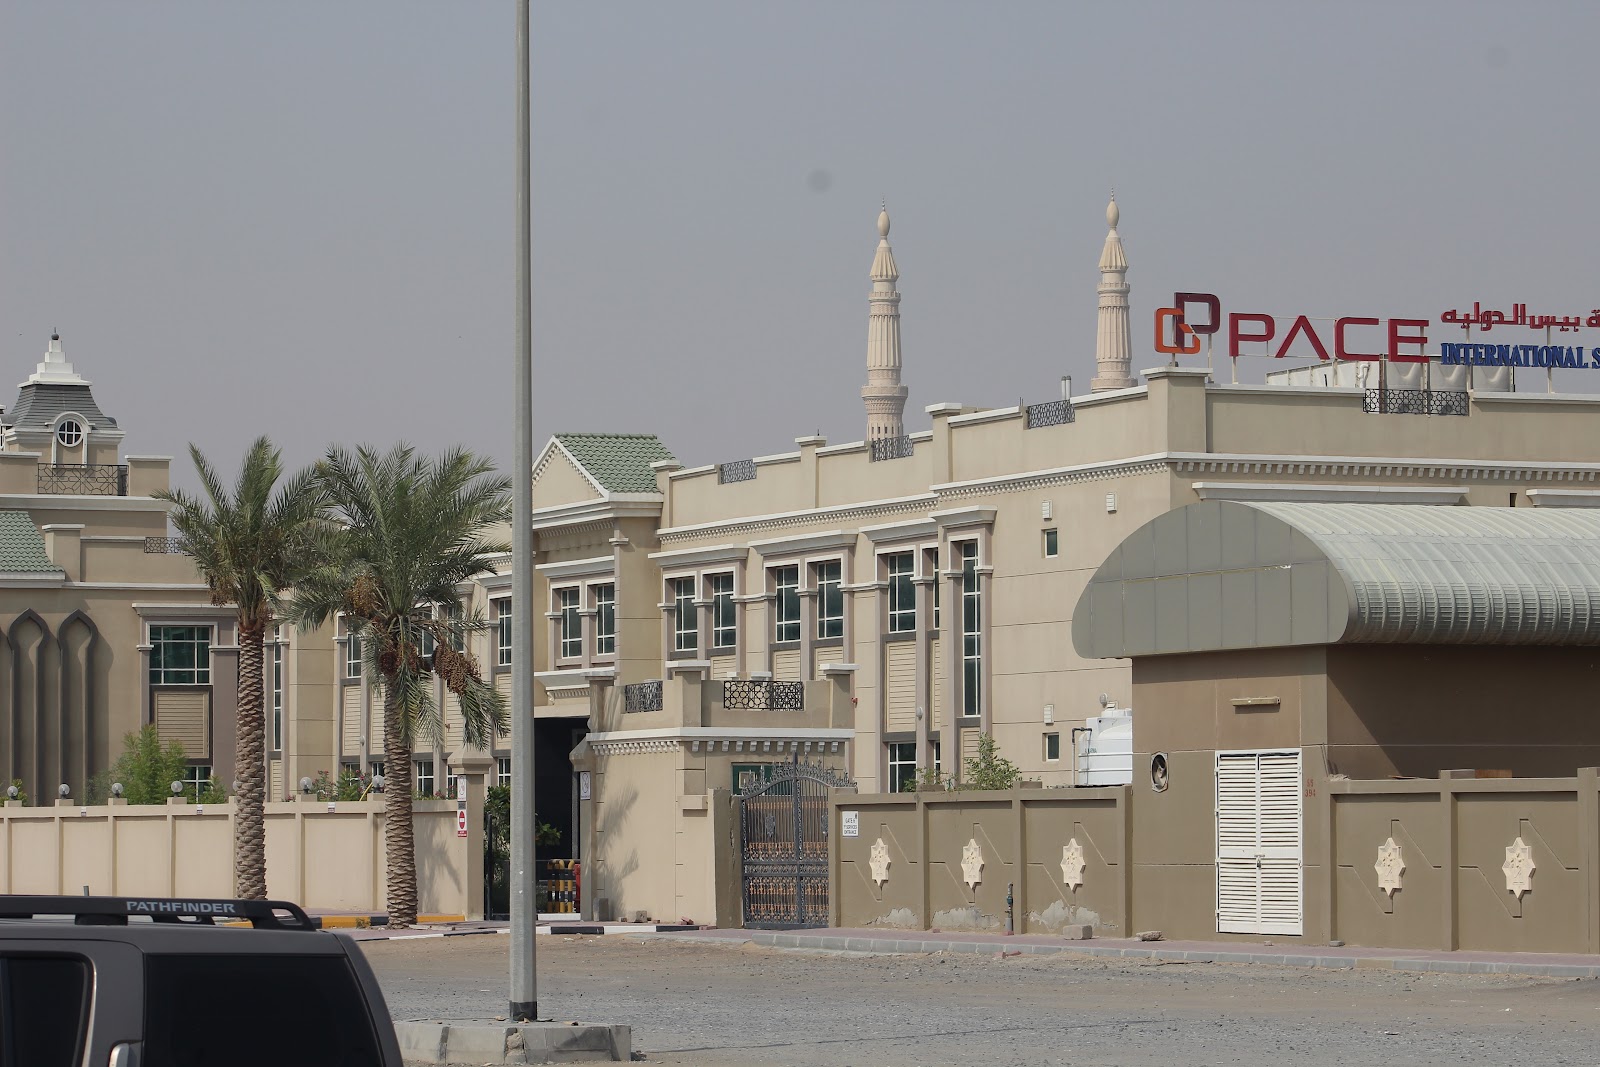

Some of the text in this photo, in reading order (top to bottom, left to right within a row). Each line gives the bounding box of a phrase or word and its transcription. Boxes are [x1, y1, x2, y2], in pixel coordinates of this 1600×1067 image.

[1530, 315, 1580, 332] بيس
[1229, 312, 1430, 363] PACE
[1440, 343, 1588, 368] INTERNATIONAL
[126, 901, 236, 913] PATHFINDER
